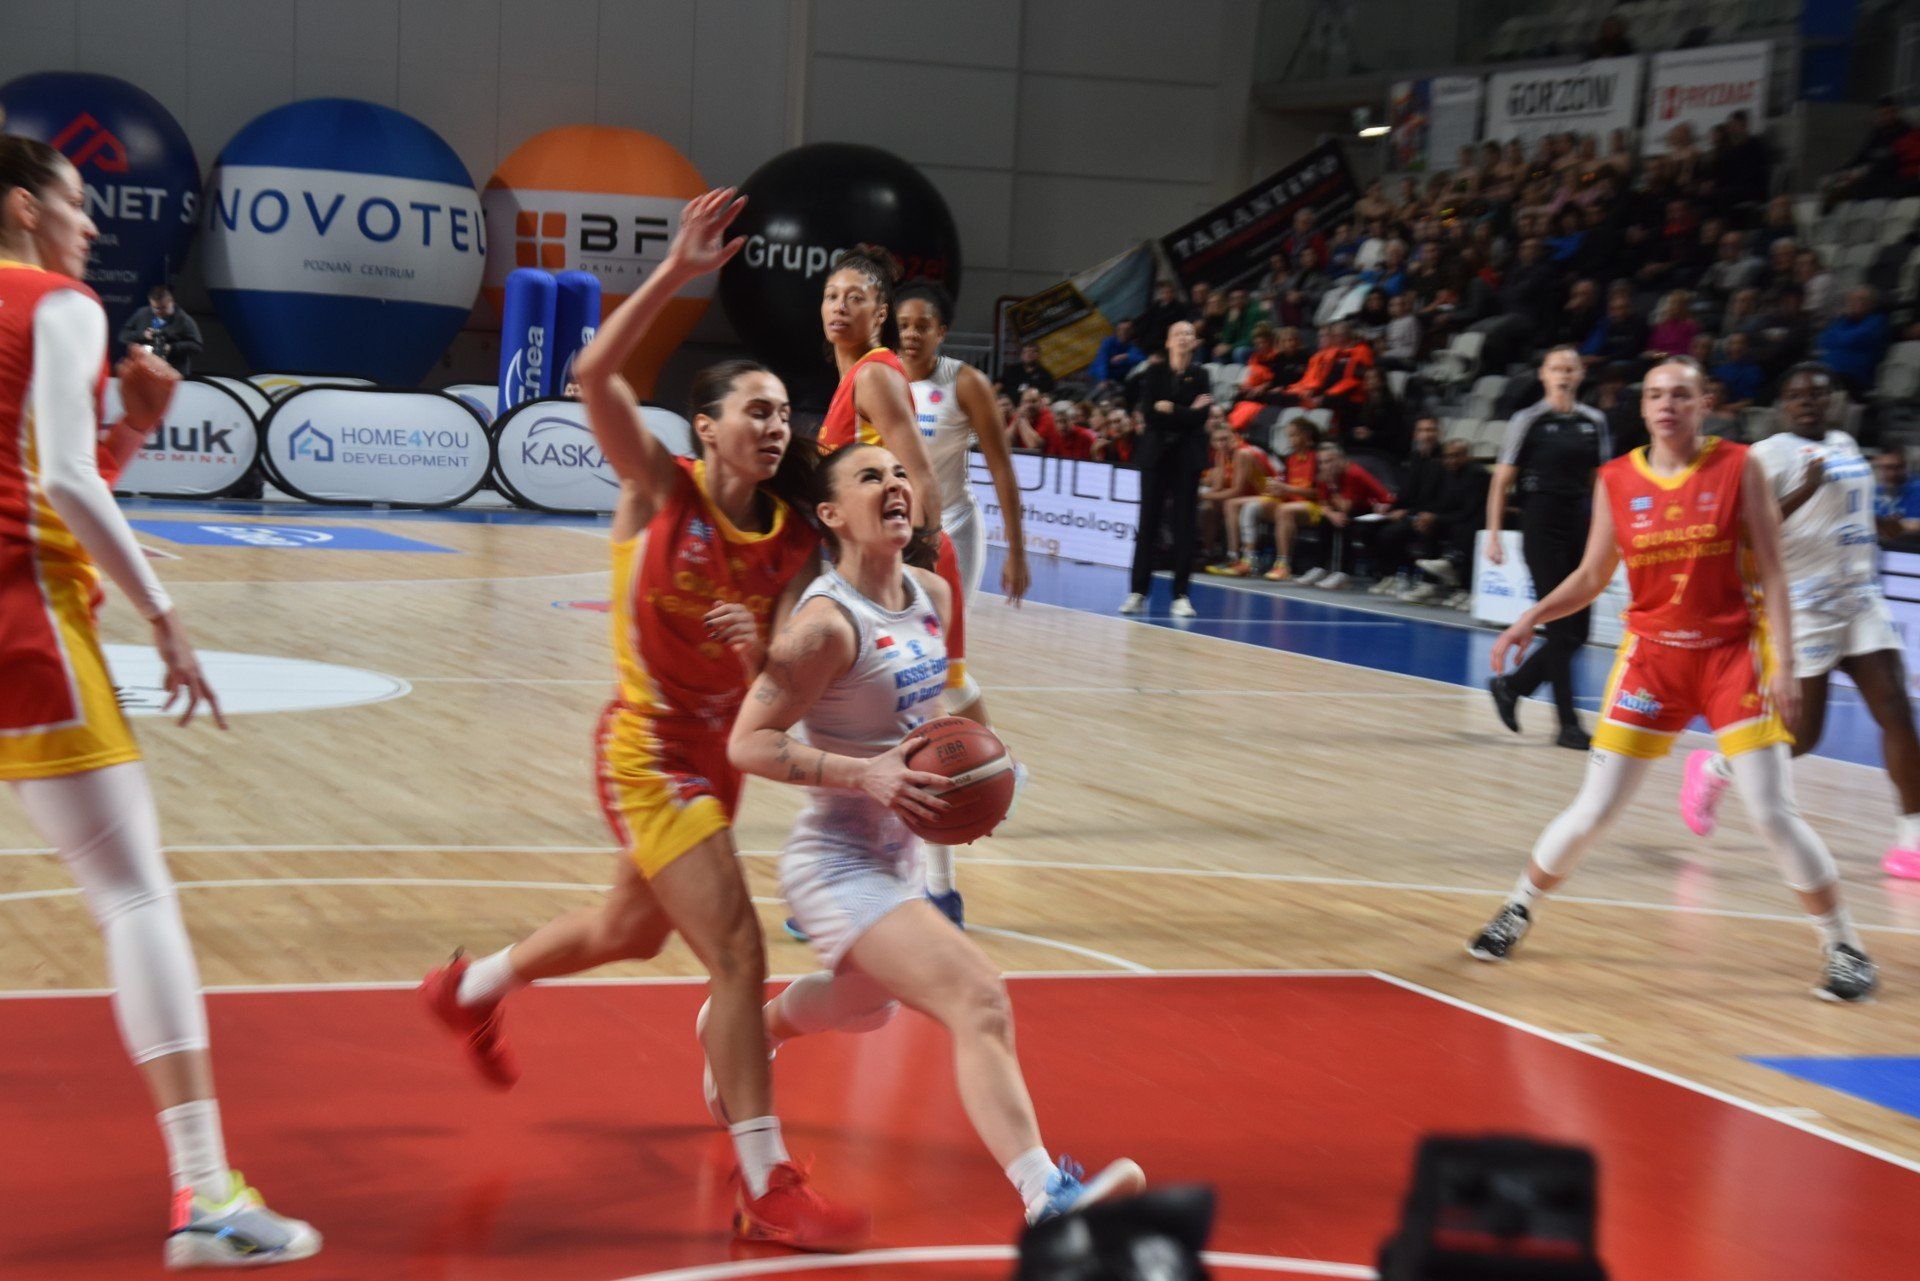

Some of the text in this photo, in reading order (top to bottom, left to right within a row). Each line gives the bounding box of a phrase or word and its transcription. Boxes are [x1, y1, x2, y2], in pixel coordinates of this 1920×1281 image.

[84, 183, 168, 221] NET
[208, 188, 486, 256] NOVOTEL
[303, 258, 415, 279] POZNAŃ CENTRUM
[579, 263, 624, 274] OKNA
[341, 427, 469, 448] HOME4YOU
[138, 452, 238, 465] KOMINKI
[342, 452, 469, 467] DEVELOPMENT
[1670, 574, 1690, 605] 7
[936, 741, 965, 758] FIBA
